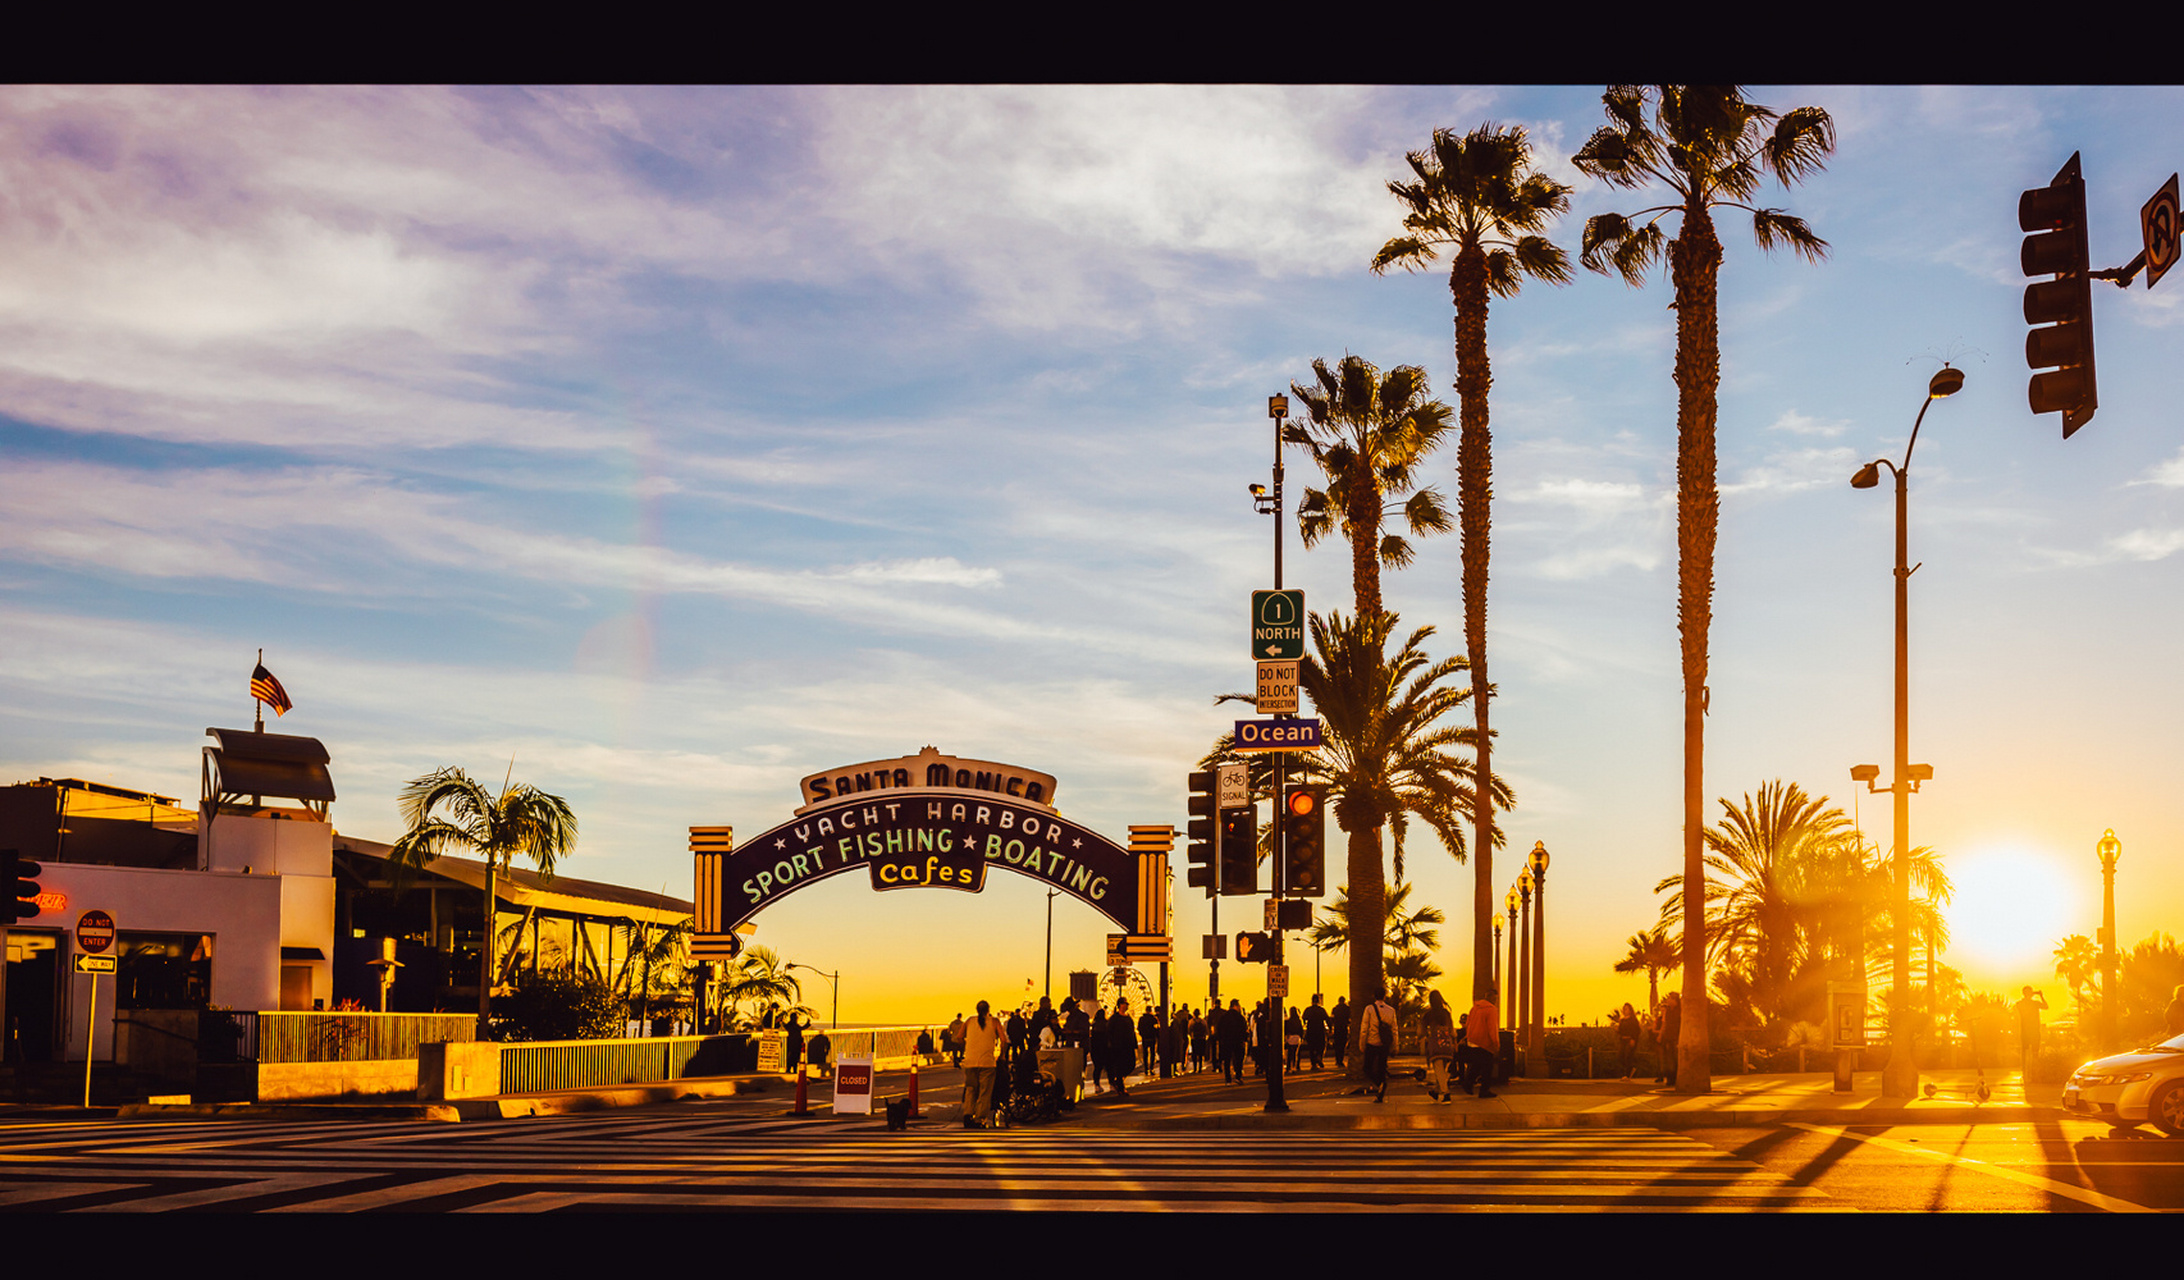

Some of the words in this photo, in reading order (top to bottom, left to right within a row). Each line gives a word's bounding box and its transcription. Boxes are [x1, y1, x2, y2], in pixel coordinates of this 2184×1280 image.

[1275, 603, 1281, 619] 1
[1255, 627, 1301, 640] NORTH
[1259, 668, 1273, 680] DO
[1276, 667, 1296, 680] NOT
[1259, 684, 1296, 697] BLOCK
[1259, 699, 1296, 709] INTERSECTION
[1241, 723, 1314, 742] Ocean
[809, 768, 908, 803] SANTA
[926, 763, 1042, 799] MONICA
[1222, 791, 1246, 801] SIGNAL
[794, 803, 901, 843] YACHT
[927, 802, 1062, 844] HARBOR
[742, 845, 824, 904] SPORT
[838, 828, 953, 863] FISHING
[984, 833, 1110, 900] BOATING
[82, 918, 93, 926] DO
[96, 918, 110, 927] NOT
[83, 937, 106, 946] ENTER
[840, 1076, 868, 1085] CLOSED
